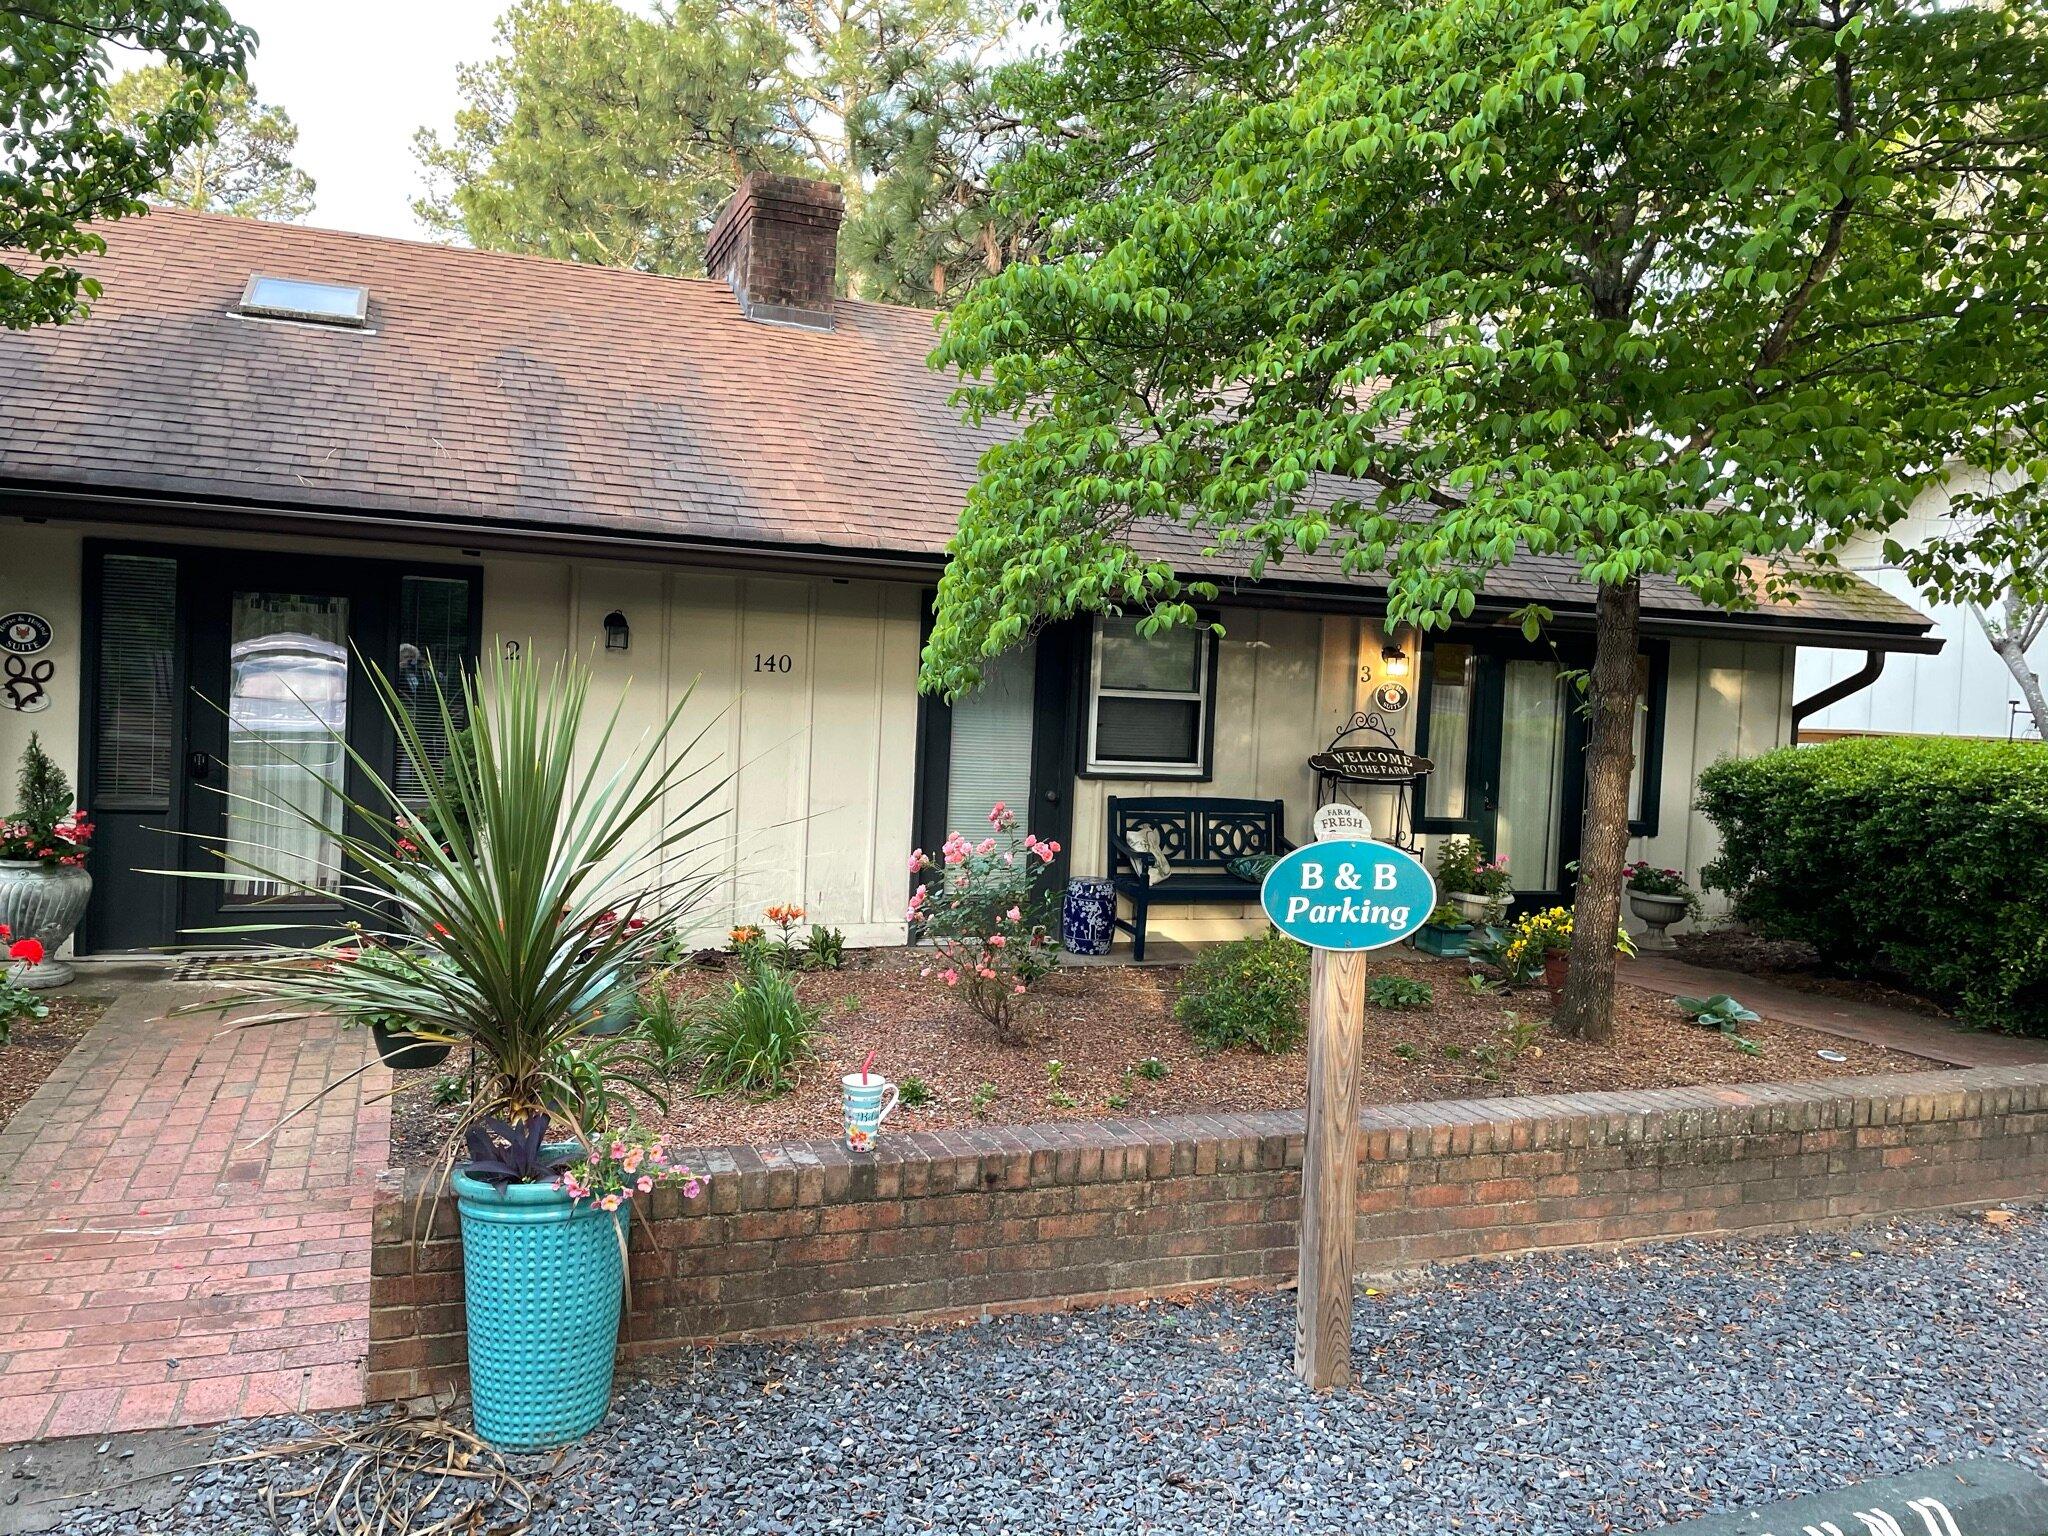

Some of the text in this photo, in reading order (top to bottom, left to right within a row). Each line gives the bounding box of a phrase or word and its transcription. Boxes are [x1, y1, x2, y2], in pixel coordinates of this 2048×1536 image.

[6, 640, 41, 651] SUITE
[505, 640, 520, 660] 2
[754, 653, 792, 673] 140
[1360, 665, 1372, 683] 3
[1383, 702, 1402, 710] SUITE
[1332, 750, 1413, 767] WELCOME
[1343, 764, 1410, 775] TO THE FARM
[1327, 808, 1351, 817] FARM
[1321, 817, 1363, 829] FRESH
[1301, 862, 1397, 890] B & B
[1285, 896, 1410, 930] Parking
